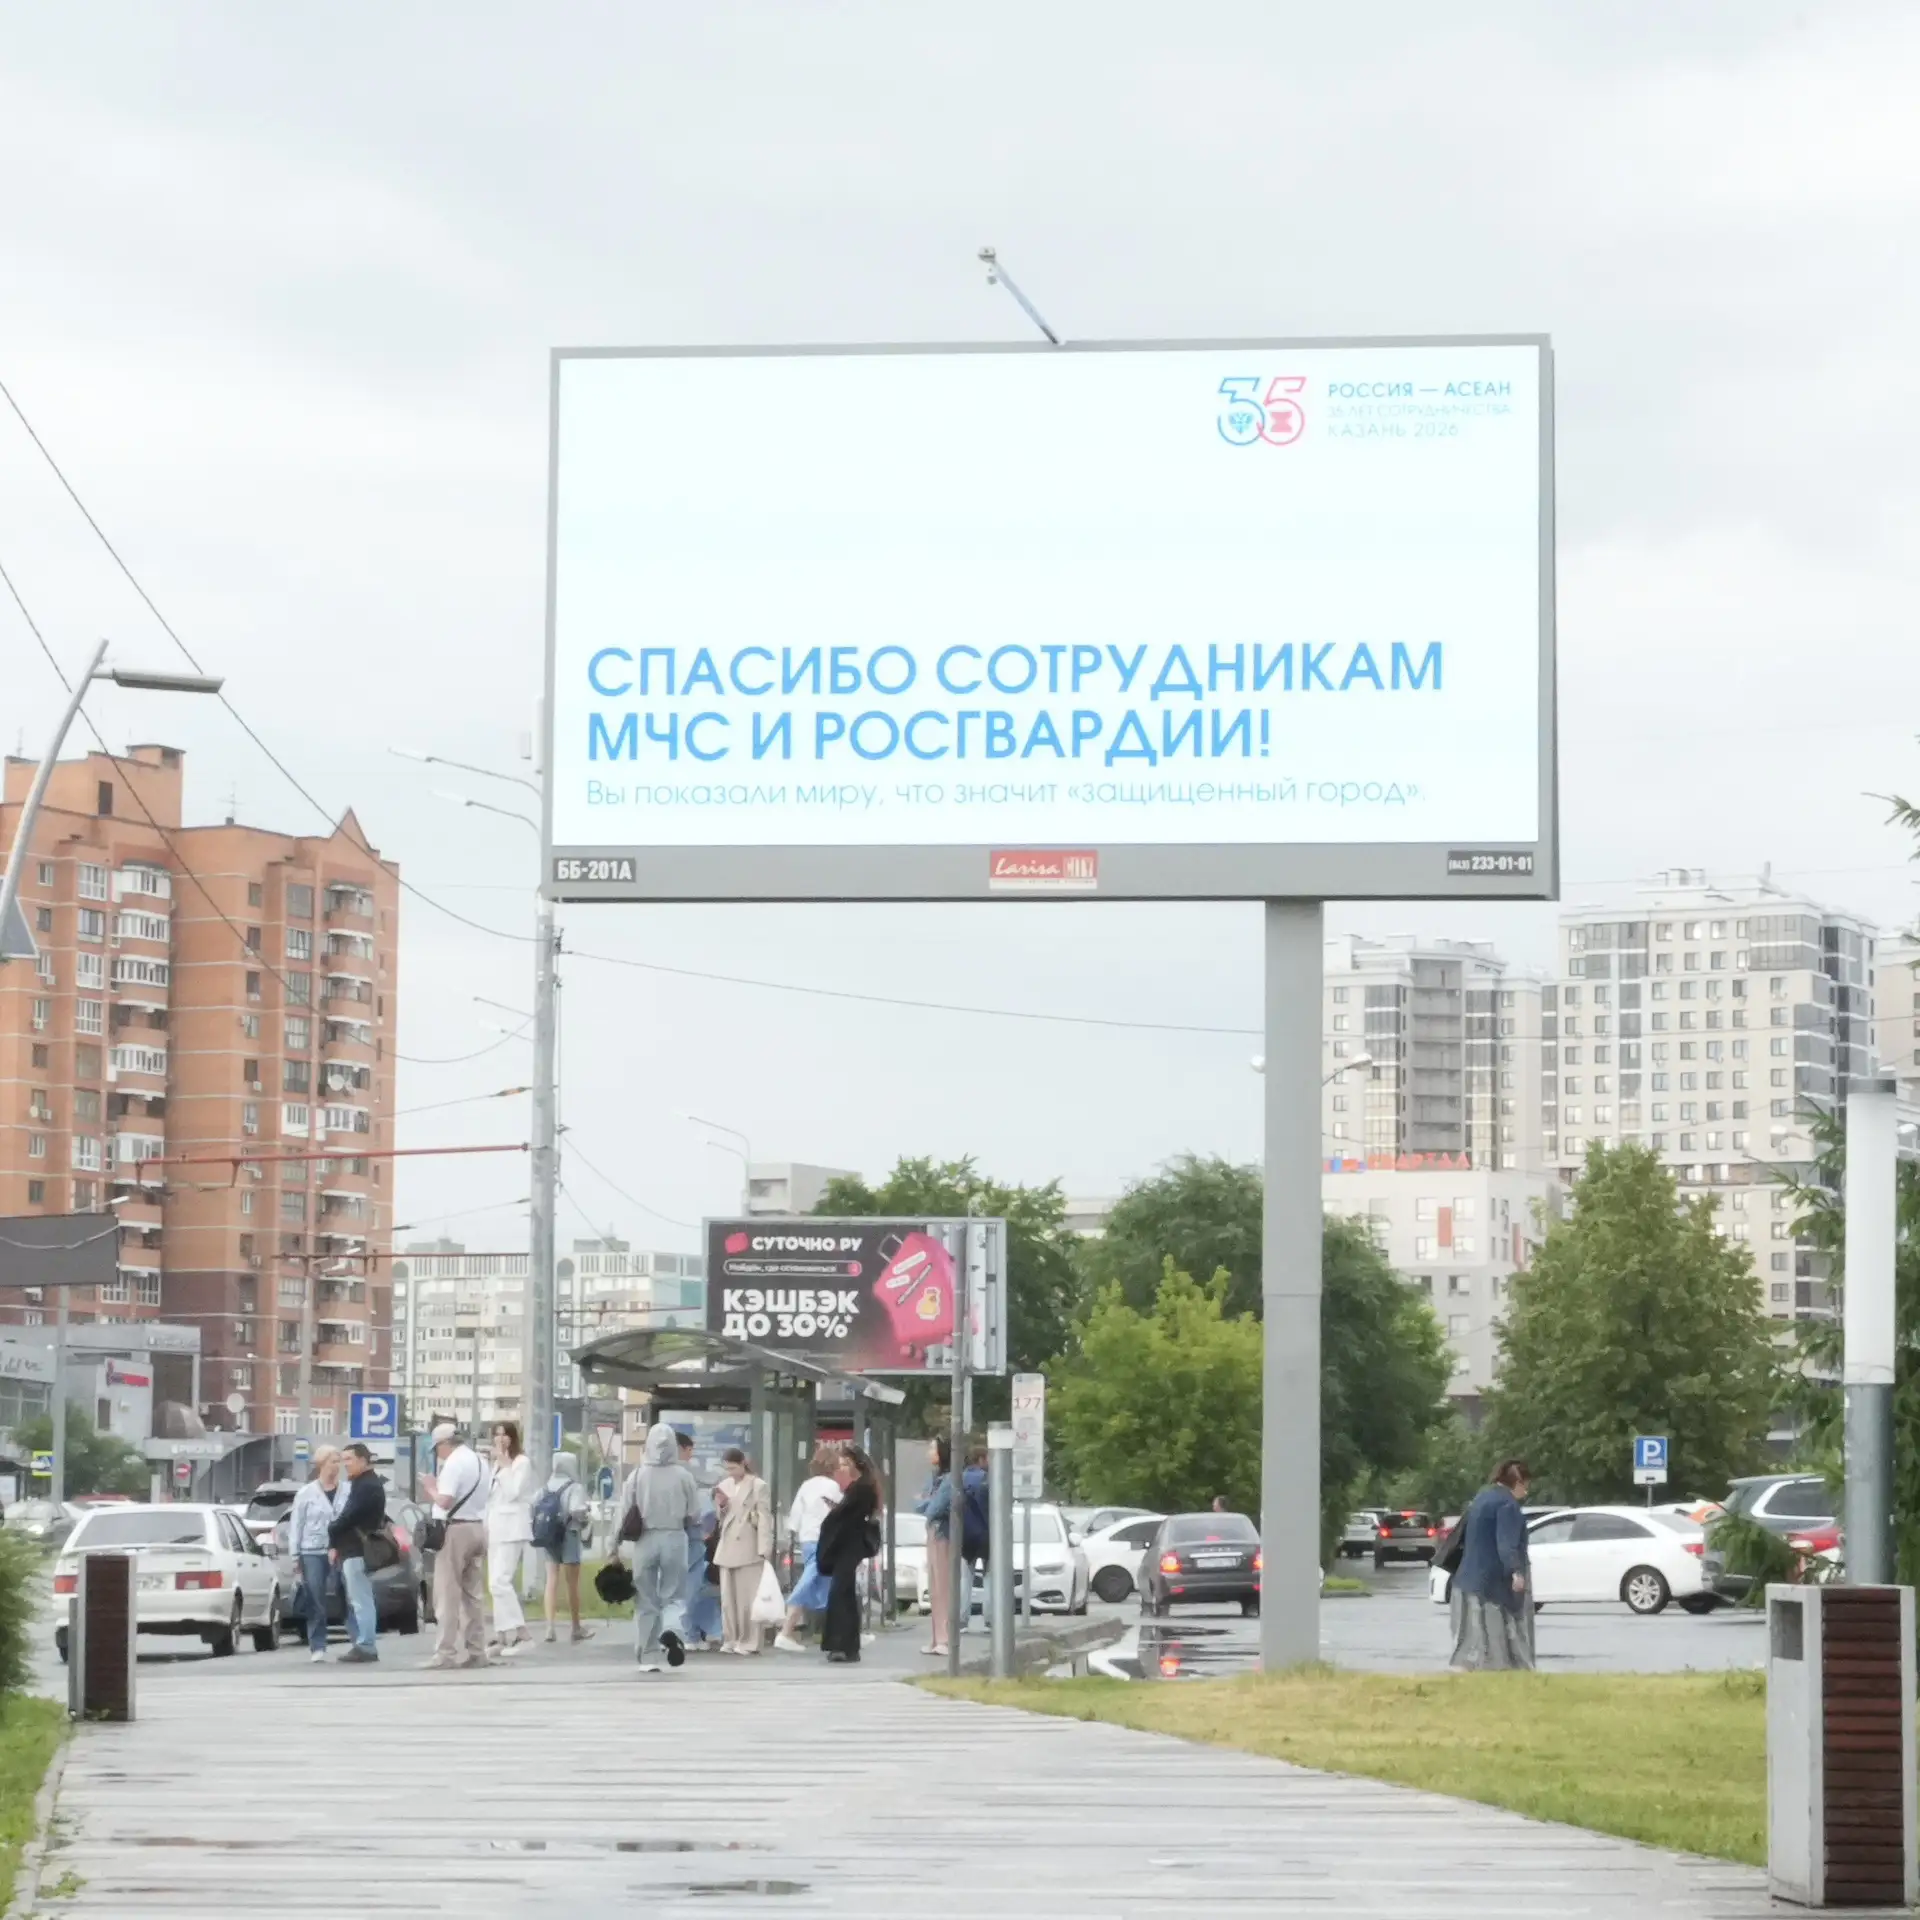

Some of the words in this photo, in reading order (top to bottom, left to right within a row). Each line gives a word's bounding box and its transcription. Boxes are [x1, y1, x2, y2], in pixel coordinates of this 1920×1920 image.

[1328, 382, 1413, 398] РОССИЯ
[1444, 381, 1511, 397] АСЕАН
[1328, 423, 1406, 438] КАЗАНЬ
[1414, 422, 1459, 437] 2026
[588, 645, 916, 697] СПАСИБО
[936, 642, 1442, 701] СОТРУДНИКАМ
[589, 711, 730, 761] МЧС
[752, 711, 791, 760] И
[815, 709, 1270, 767] РОСГВАРДИИ!
[587, 780, 625, 805] Вы
[634, 784, 786, 806] показали
[796, 784, 885, 811] миру,
[895, 784, 945, 804] что
[954, 784, 1057, 804] значит
[1068, 776, 1297, 806] «защищенный
[557, 860, 632, 880] ББ-201А
[995, 857, 1060, 875] Larisa
[1472, 855, 1532, 870] 233-01-01
[723, 1289, 860, 1314] КЭШБЭК
[722, 1313, 771, 1341] ДО
[1014, 1396, 1042, 1410] 177
[362, 1397, 389, 1435] P
[1643, 1440, 1661, 1465] P
